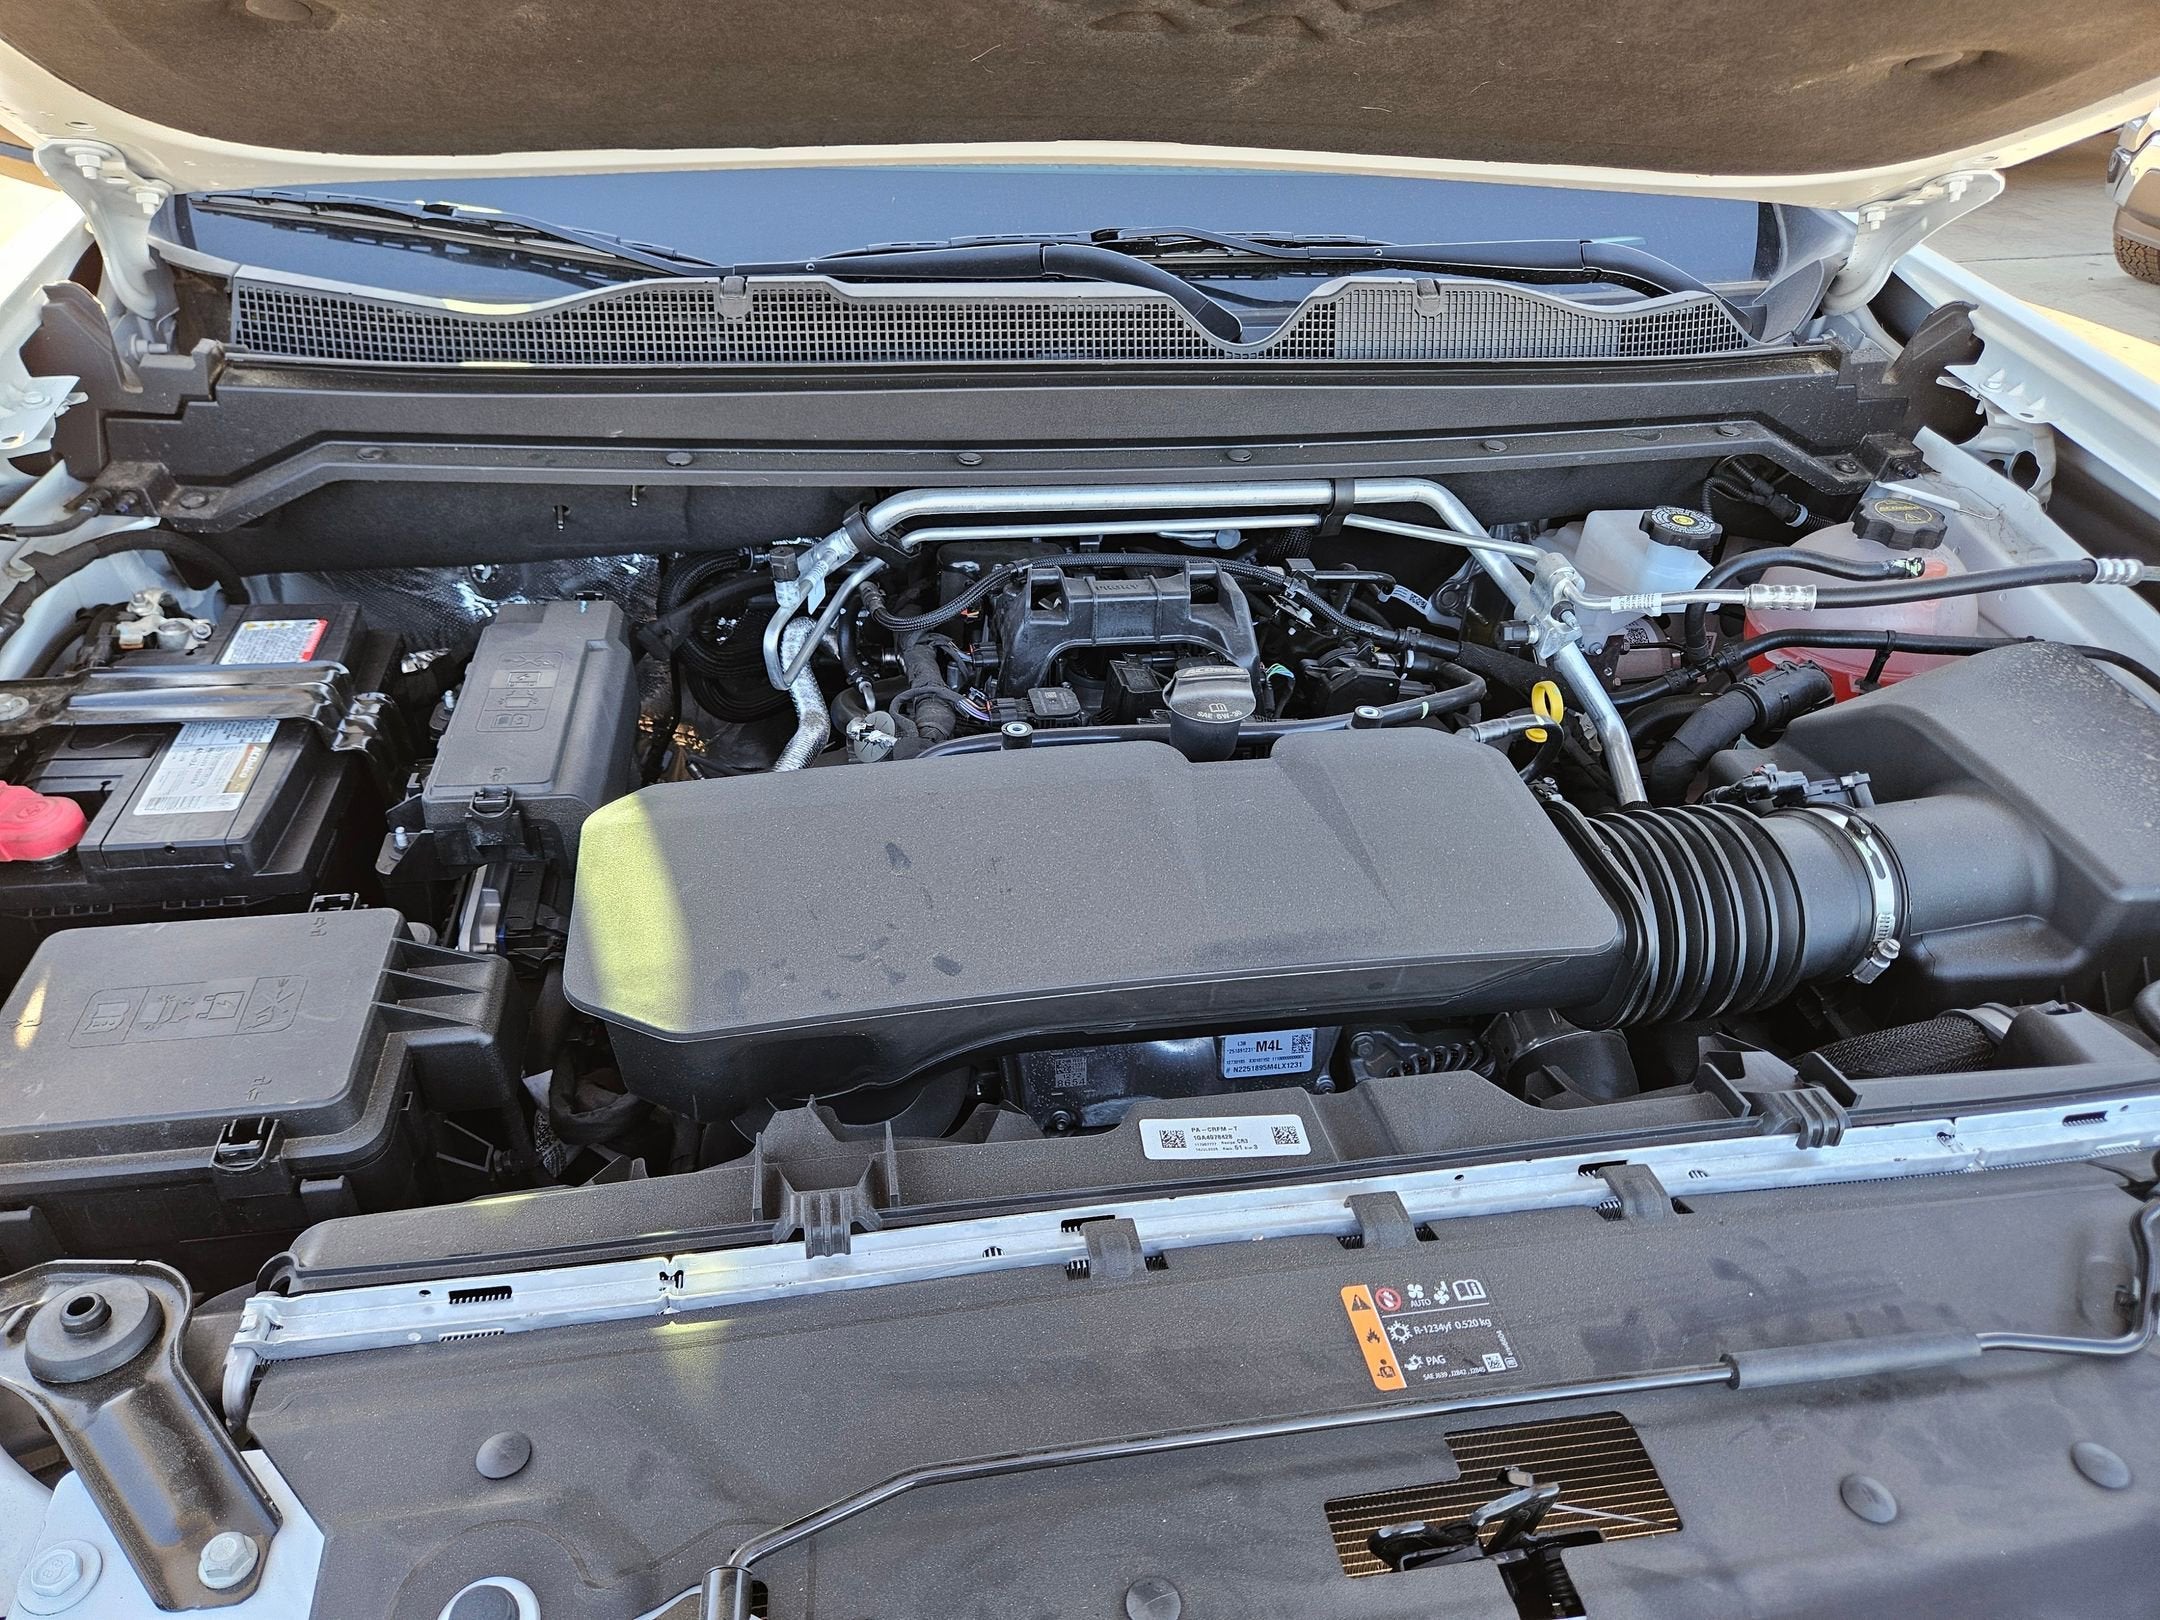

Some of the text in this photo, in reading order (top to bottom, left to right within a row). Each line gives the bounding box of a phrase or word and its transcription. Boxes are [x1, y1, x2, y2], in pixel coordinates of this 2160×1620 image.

[1197, 711, 1213, 719] SAE
[1256, 1040, 1283, 1052] M4L
[1410, 1298, 1432, 1308] AUTO
[1413, 1317, 1492, 1335] R-1234yf 0.520 kg
[1426, 1355, 1446, 1366] PAG
